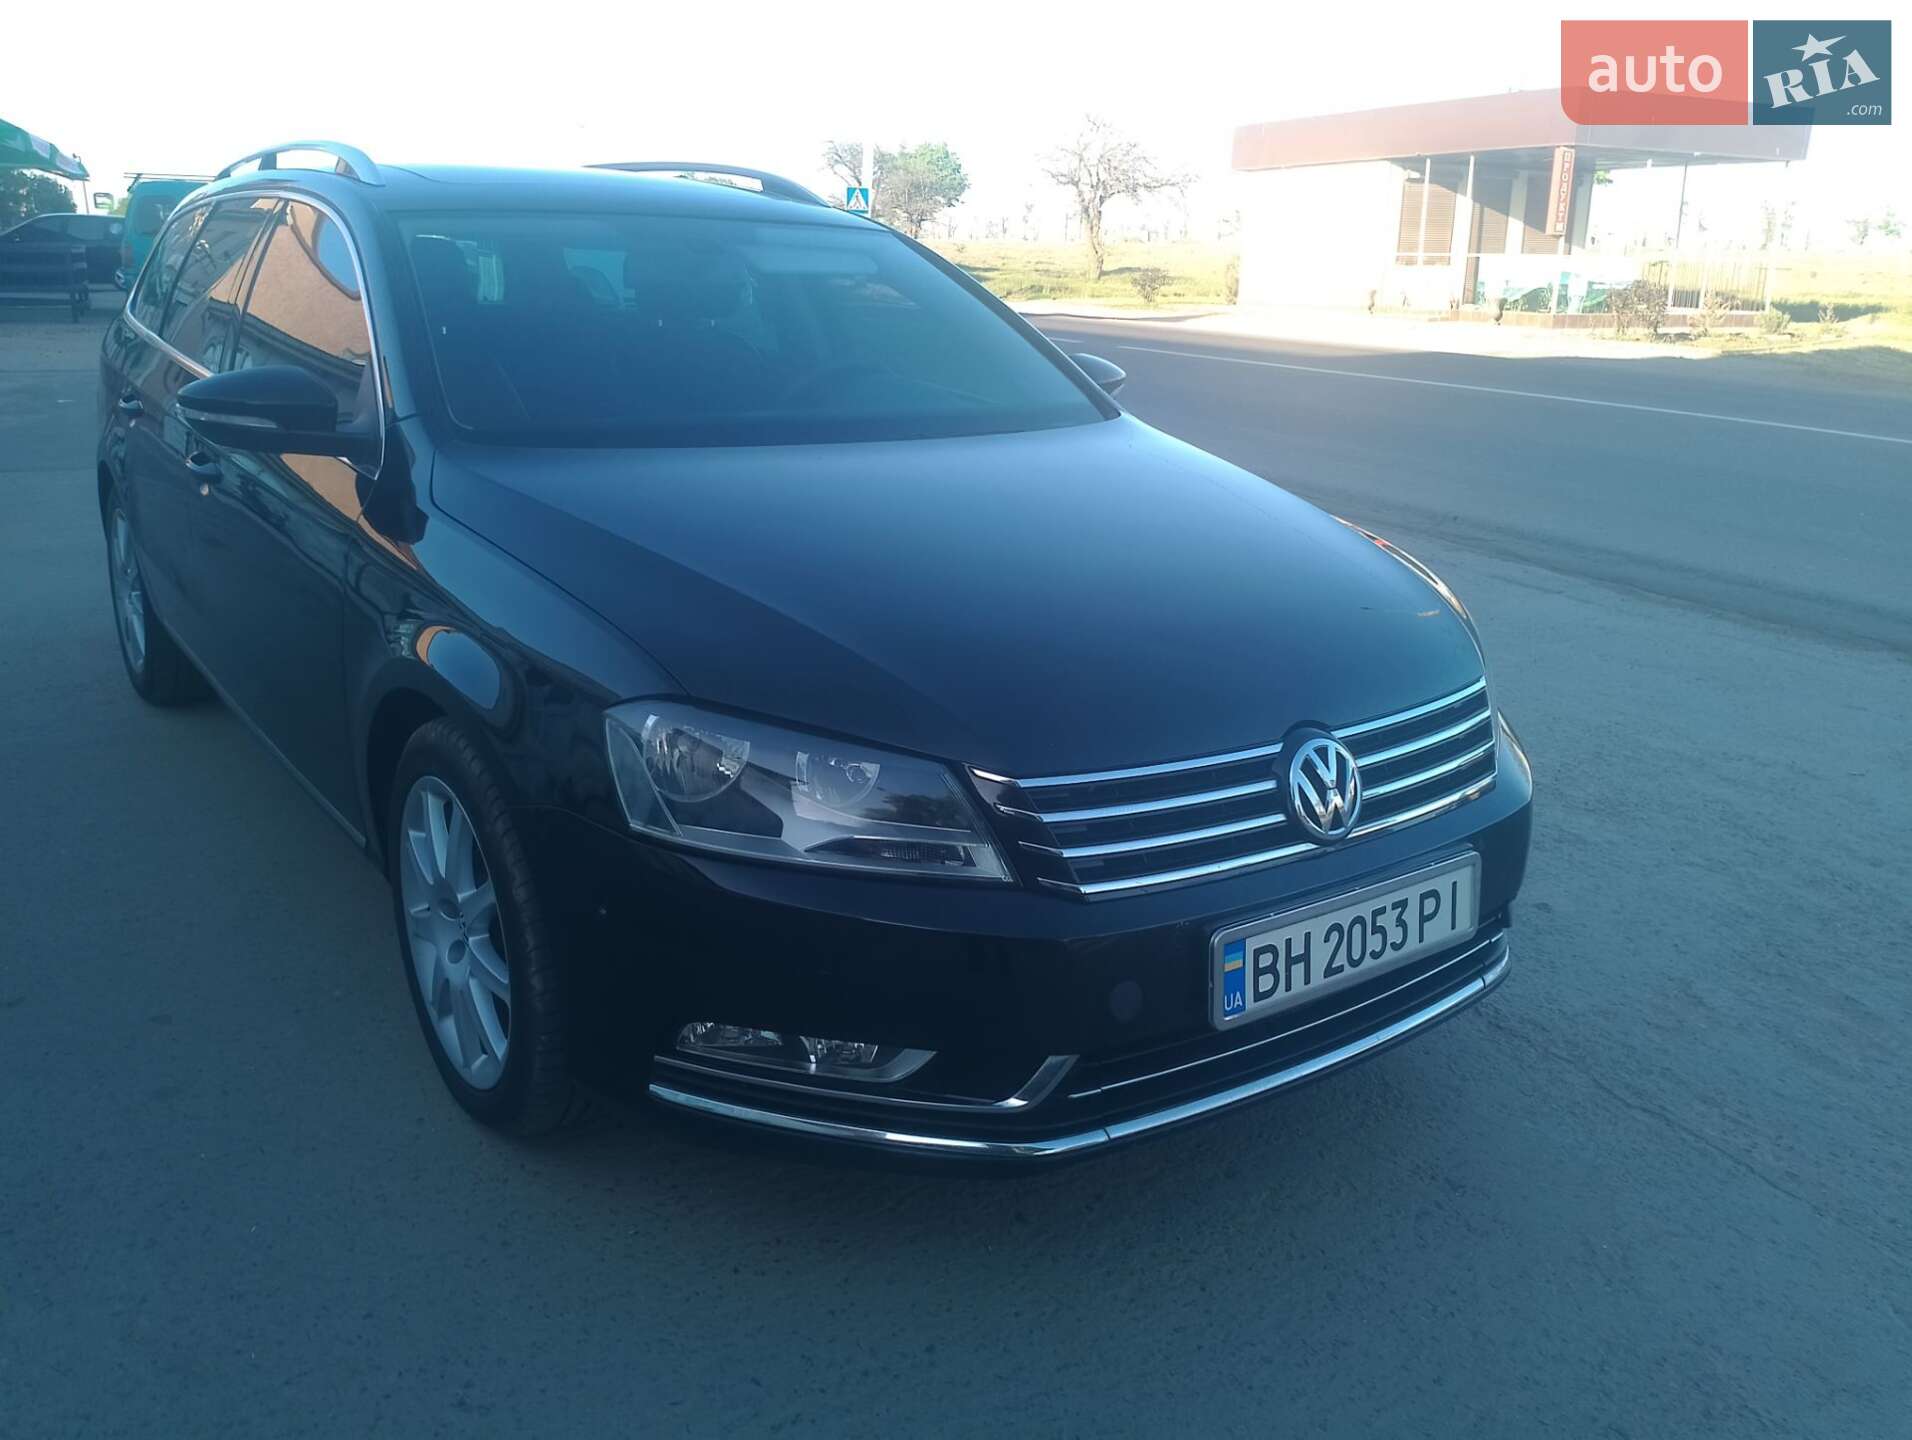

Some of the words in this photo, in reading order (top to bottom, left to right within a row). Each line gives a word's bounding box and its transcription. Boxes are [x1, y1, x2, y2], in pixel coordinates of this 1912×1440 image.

[1252, 931, 1312, 1003] BH
[1322, 897, 1409, 979] 2053
[1224, 991, 1244, 1011] UA
